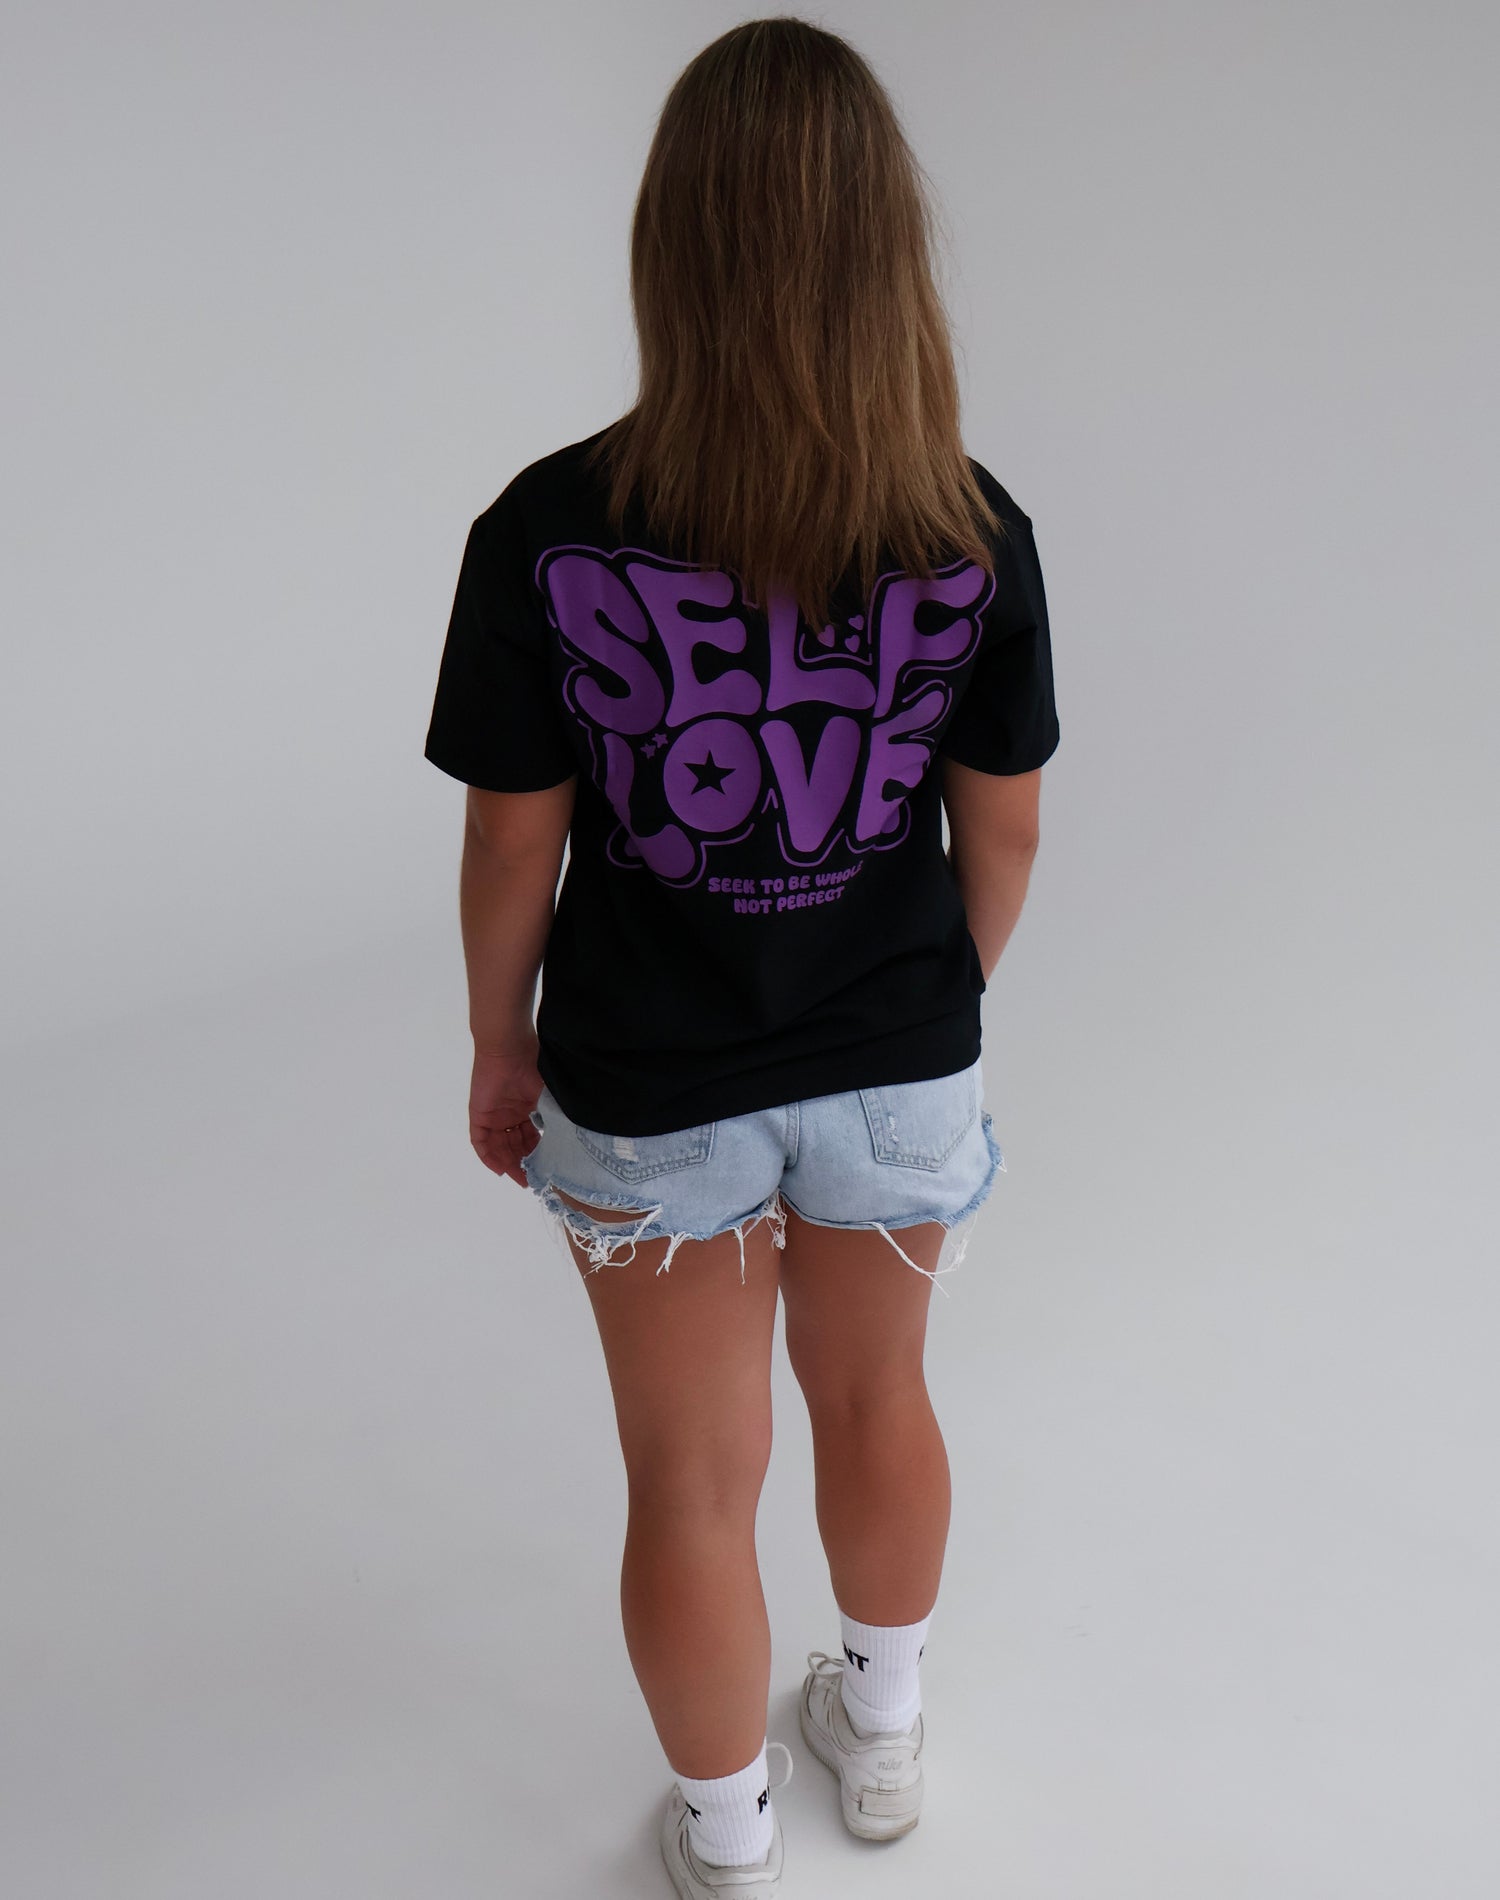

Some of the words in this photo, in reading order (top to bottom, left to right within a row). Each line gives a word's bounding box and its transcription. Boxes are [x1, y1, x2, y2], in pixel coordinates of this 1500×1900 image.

[546, 554, 987, 735] SELF
[602, 689, 945, 879] LOVE
[707, 876, 756, 895] SEEK
[759, 877, 785, 895] TO
[788, 875, 811, 891] BE
[733, 898, 773, 914] NOT
[776, 885, 846, 913] PERFECT
